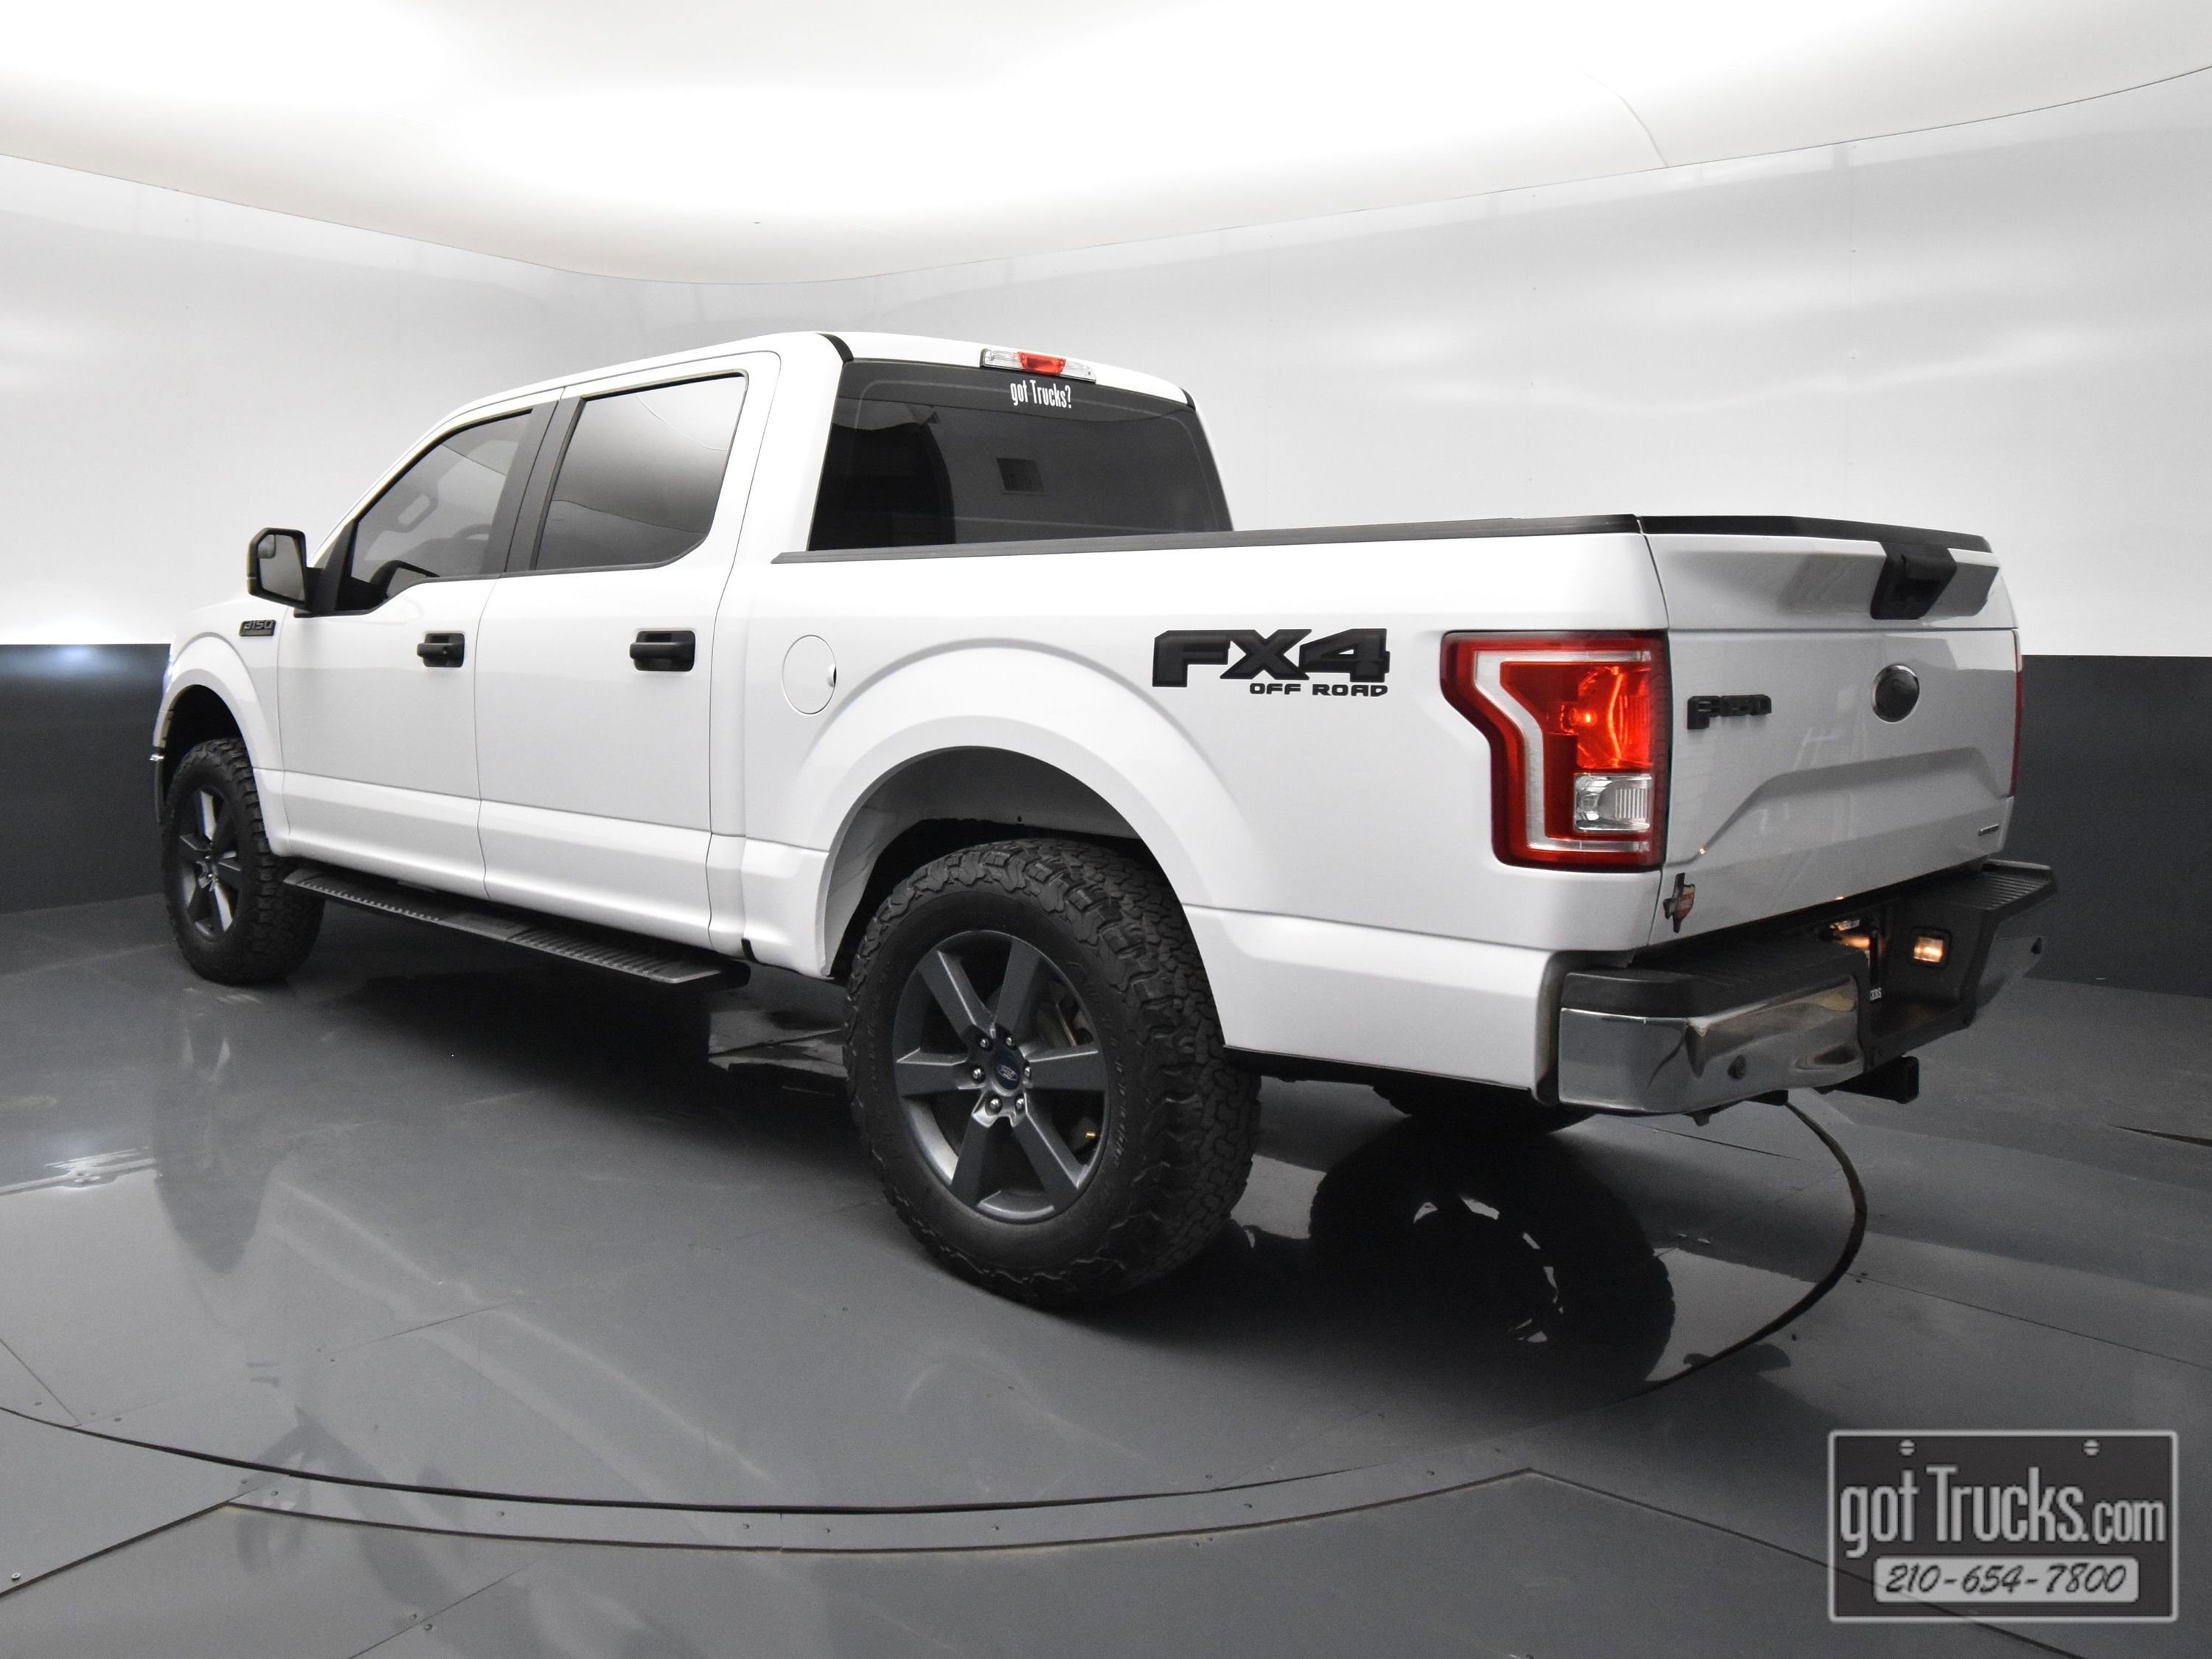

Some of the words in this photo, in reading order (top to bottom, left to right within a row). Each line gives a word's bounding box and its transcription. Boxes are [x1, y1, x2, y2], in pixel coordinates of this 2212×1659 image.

[1010, 380, 1029, 406] got
[1029, 380, 1071, 408] Trucks?
[1152, 628, 1391, 687] FX4
[1250, 683, 1301, 695] OFF
[1312, 684, 1388, 697] ROAD
